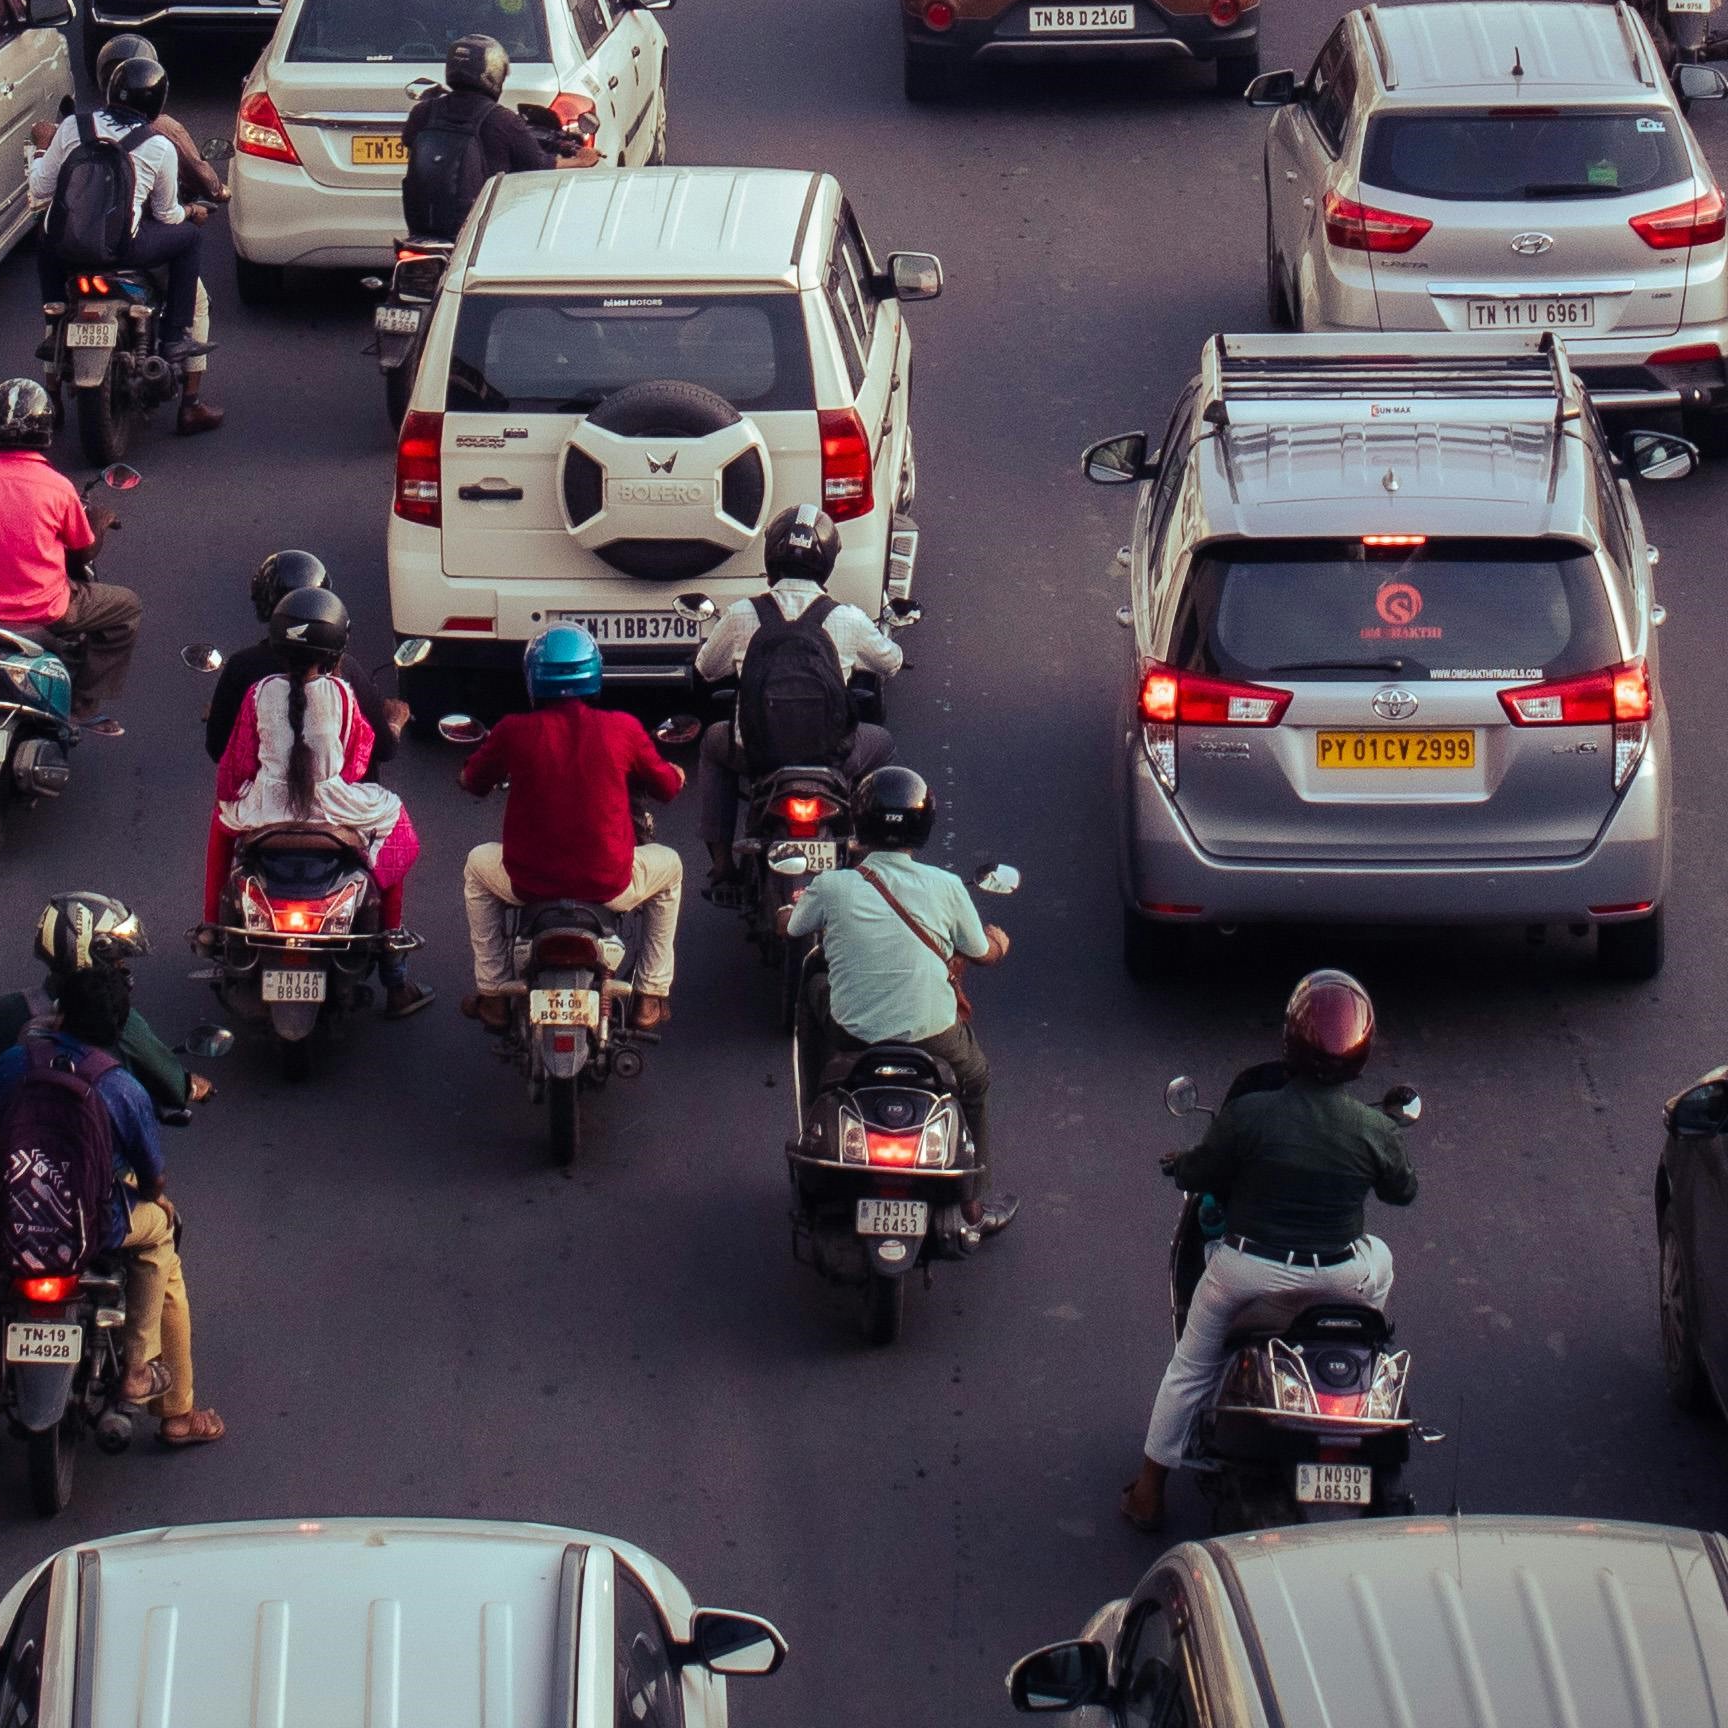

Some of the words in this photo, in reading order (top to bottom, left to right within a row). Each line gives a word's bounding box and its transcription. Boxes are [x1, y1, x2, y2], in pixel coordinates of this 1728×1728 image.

[1034, 11, 1053, 28] TN
[1057, 10, 1075, 27] 88
[1079, 10, 1089, 26] D
[1091, 8, 1128, 26] 2160
[1475, 306, 1496, 325] TN
[1504, 306, 1519, 324] 11
[1528, 306, 1538, 323] U
[1546, 305, 1589, 324] 6961
[621, 485, 702, 501] BOLERO
[1320, 740, 1348, 763] PY
[1355, 740, 1378, 762] 01
[1384, 739, 1409, 762] CV
[1415, 738, 1470, 762] 2999
[884, 813, 904, 822] TVS
[875, 1202, 919, 1219] TN31C
[872, 1219, 919, 1234] E6453
[23, 1328, 66, 1343] TN-19
[18, 1344, 70, 1359] H-4928
[1313, 1485, 1362, 1500] A8539
